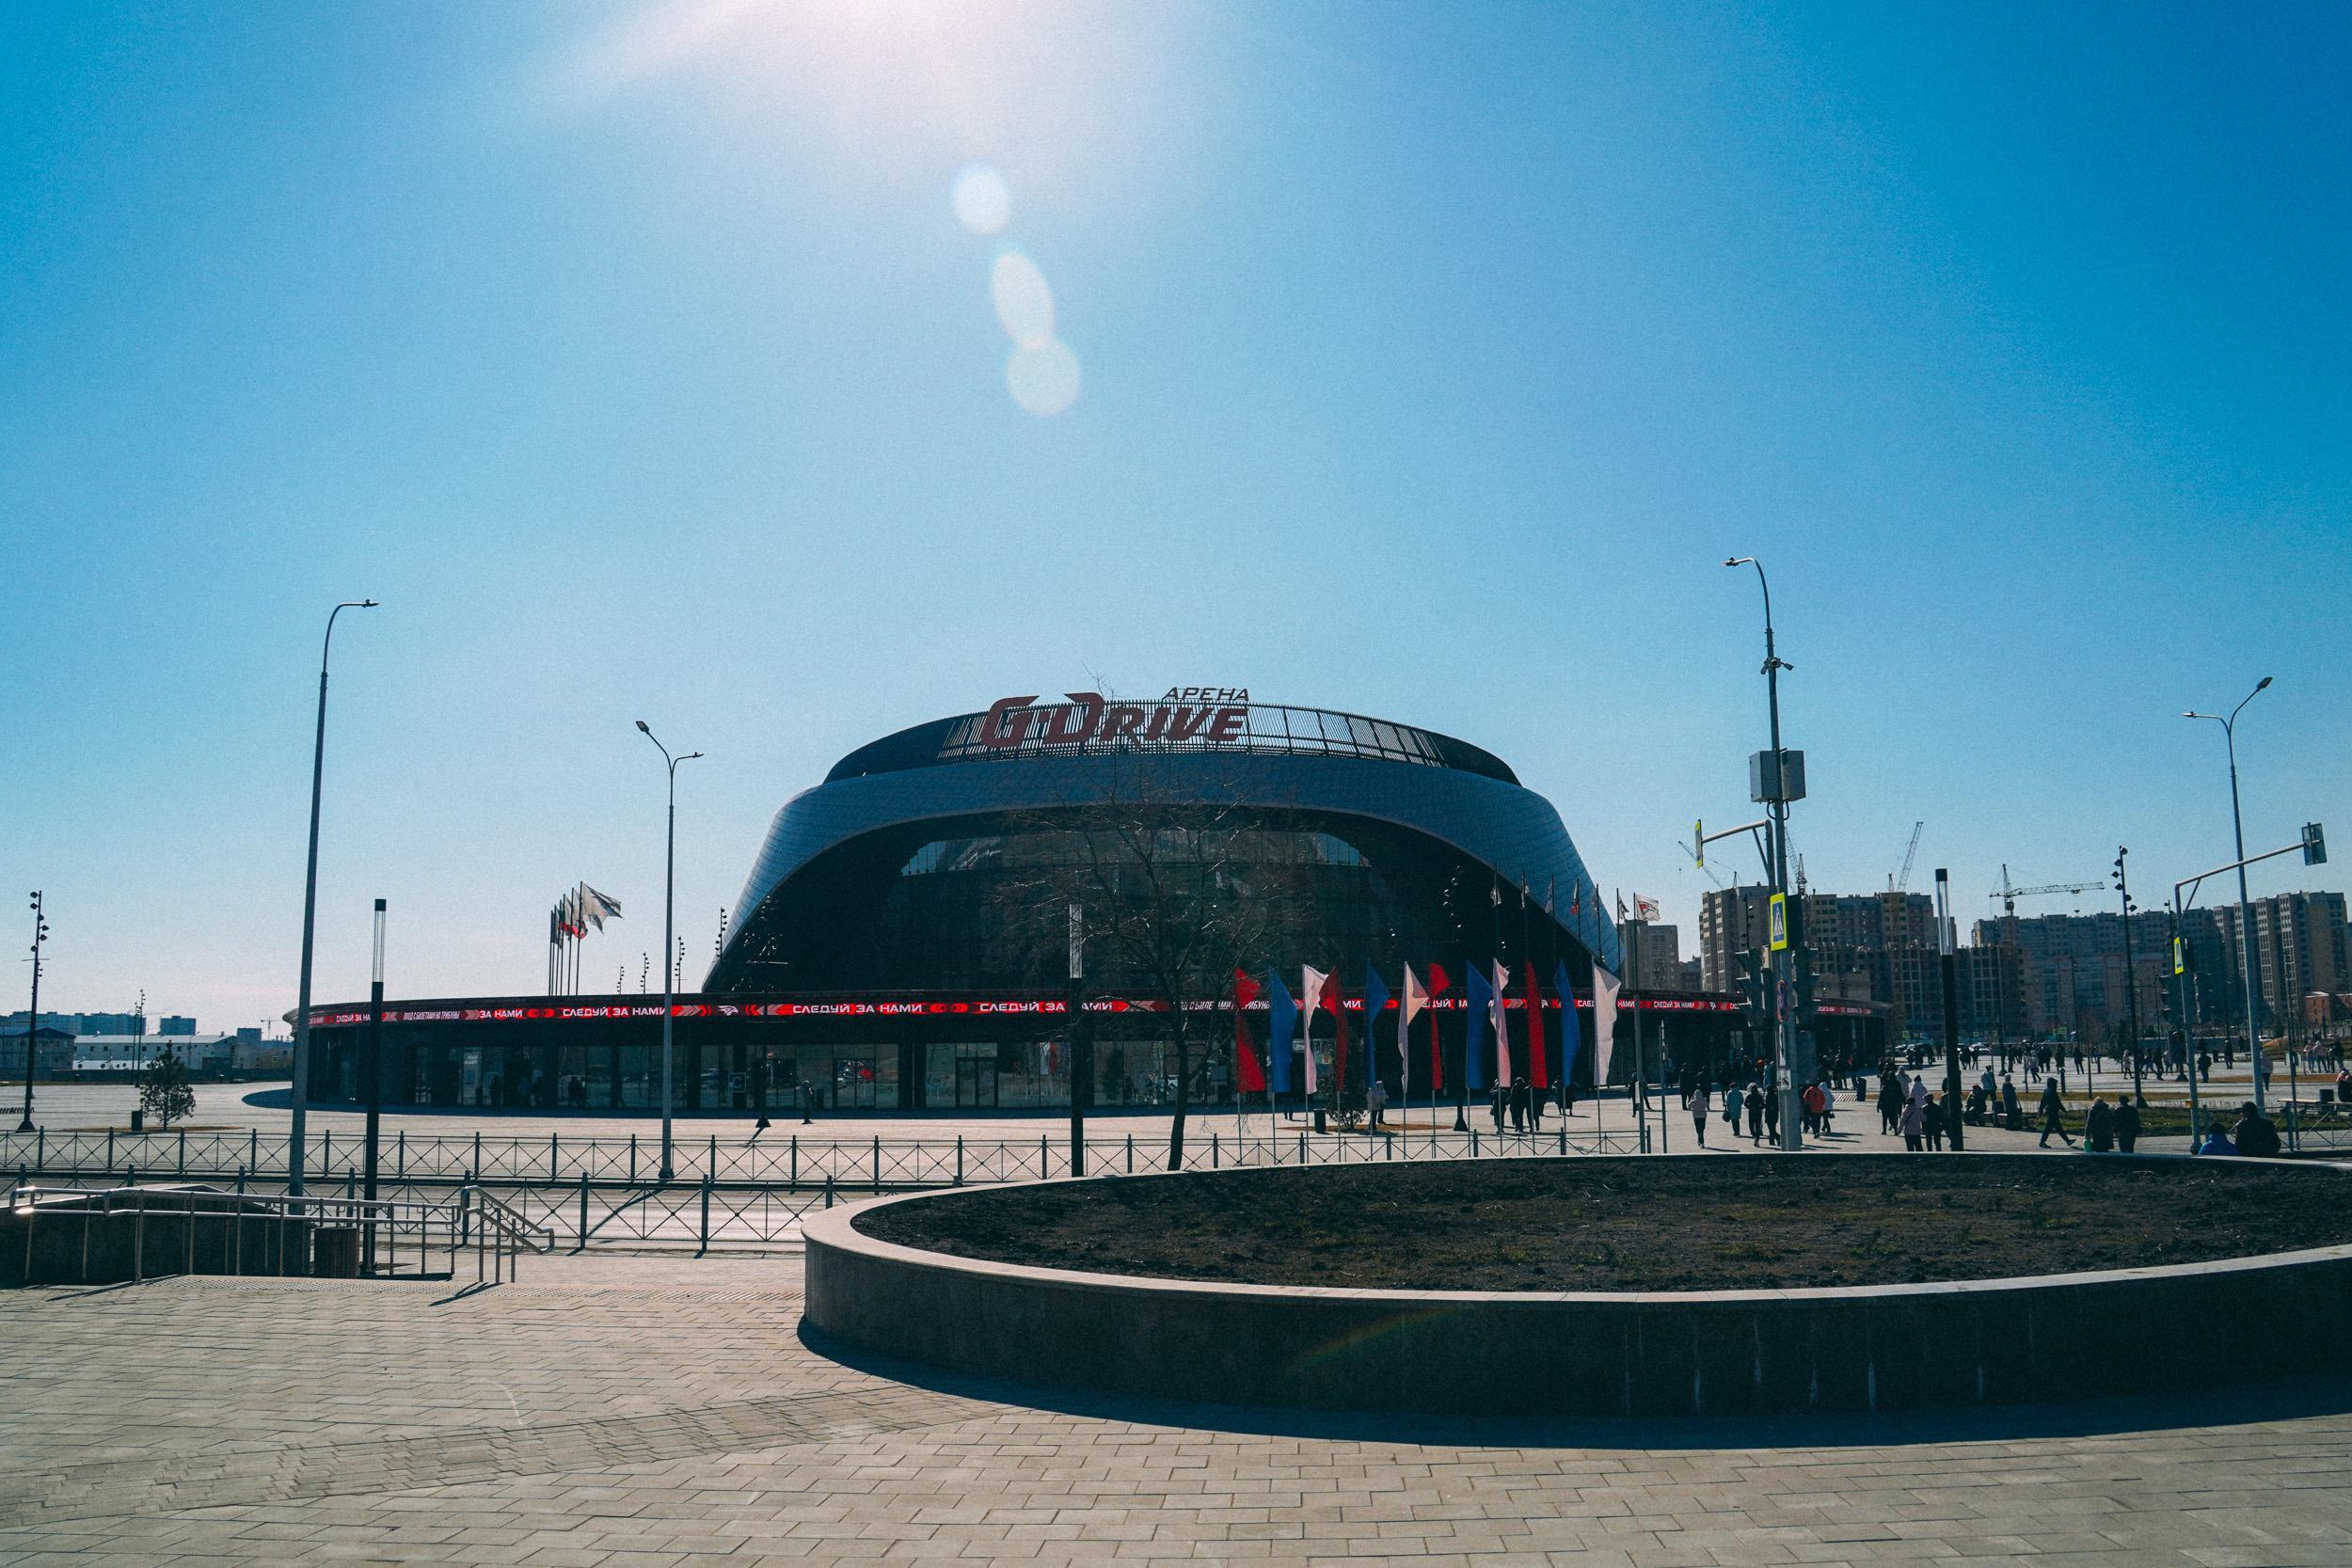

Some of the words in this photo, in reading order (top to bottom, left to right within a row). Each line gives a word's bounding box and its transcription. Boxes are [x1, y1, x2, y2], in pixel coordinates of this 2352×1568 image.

[1162, 687, 1249, 702] АРЕНА
[563, 1006, 609, 1016] СЛЕДУЙ
[612, 1007, 629, 1016] ЗА
[793, 1004, 850, 1013] СЛЕДУЙ
[856, 1005, 875, 1013] ЗА
[880, 1004, 922, 1013] НАМИ
[979, 1002, 1040, 1012] СЛЕДУЙ
[1045, 1003, 1065, 1011] ЗА
[1082, 1002, 1112, 1011] АМИ
[480, 1010, 492, 1019] ЗА
[494, 1009, 523, 1018] НАМИ
